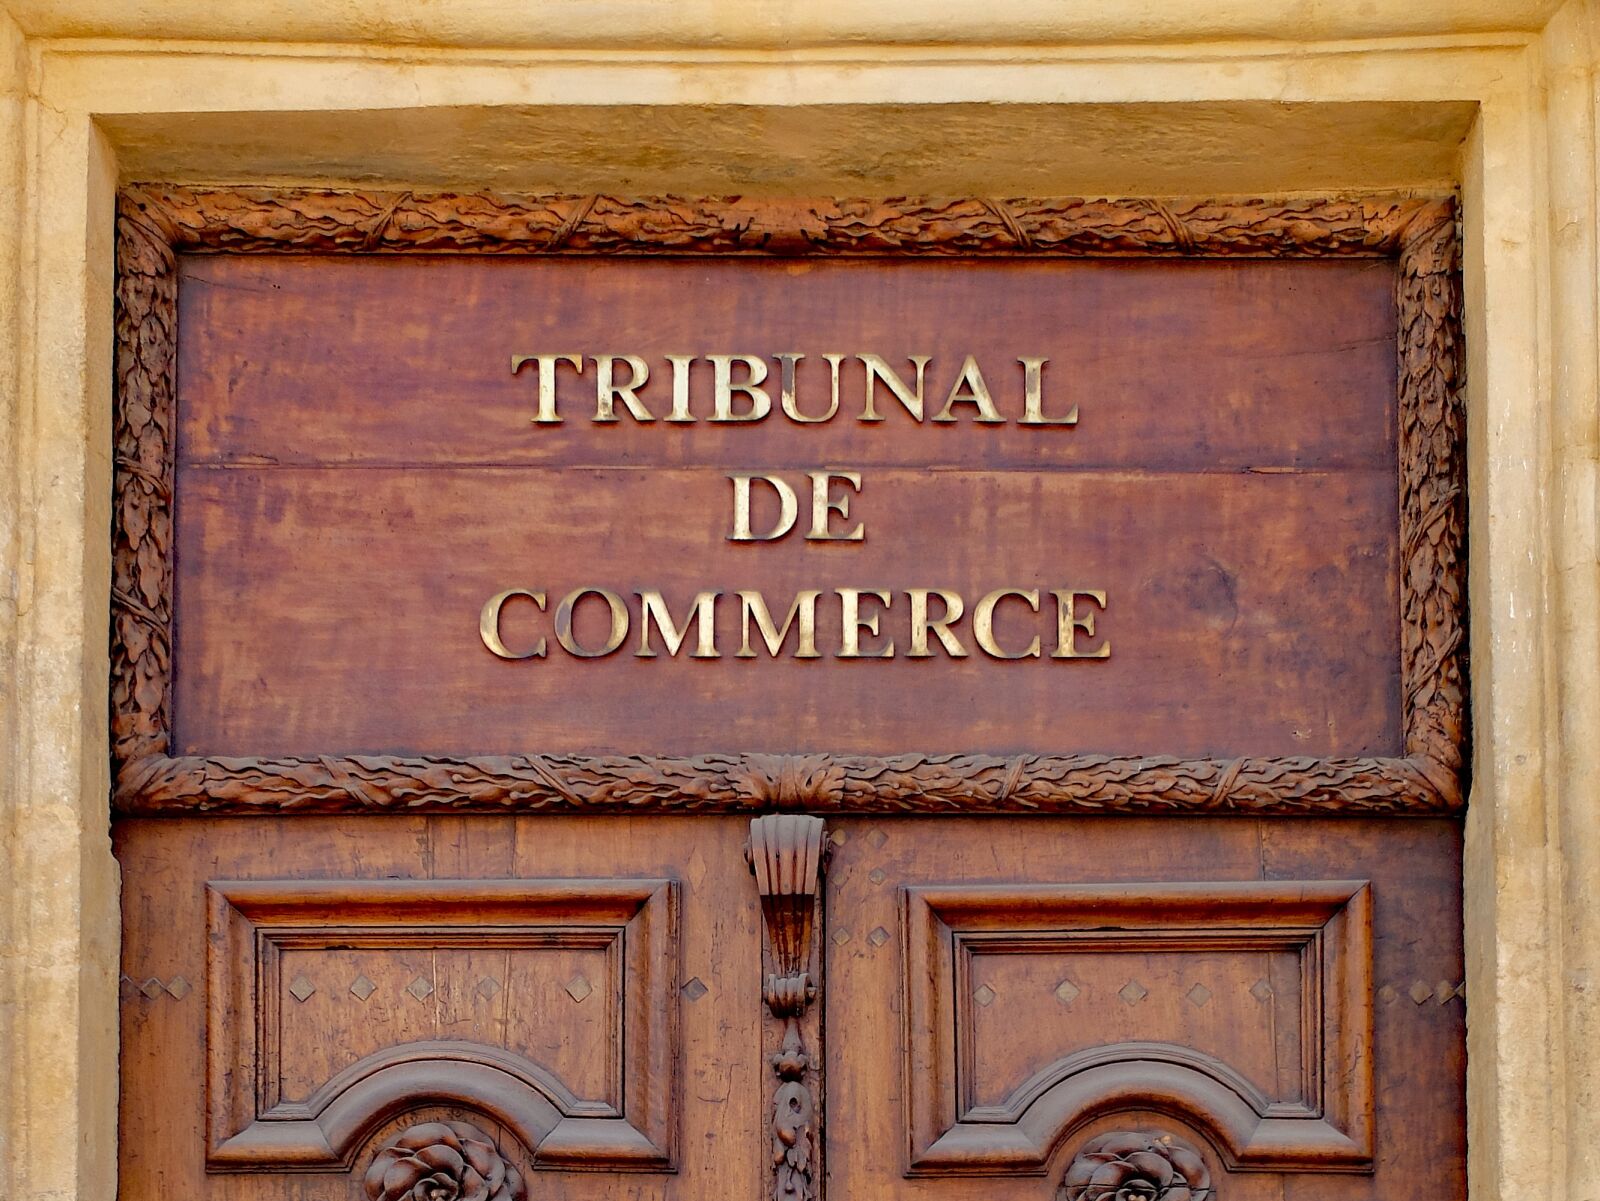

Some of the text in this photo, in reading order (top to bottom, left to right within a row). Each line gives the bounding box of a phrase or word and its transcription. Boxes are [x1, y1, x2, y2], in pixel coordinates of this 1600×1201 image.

[511, 354, 1079, 424] TRIBUNAL
[725, 471, 865, 541] DE
[479, 587, 1111, 659] COMMERCE
